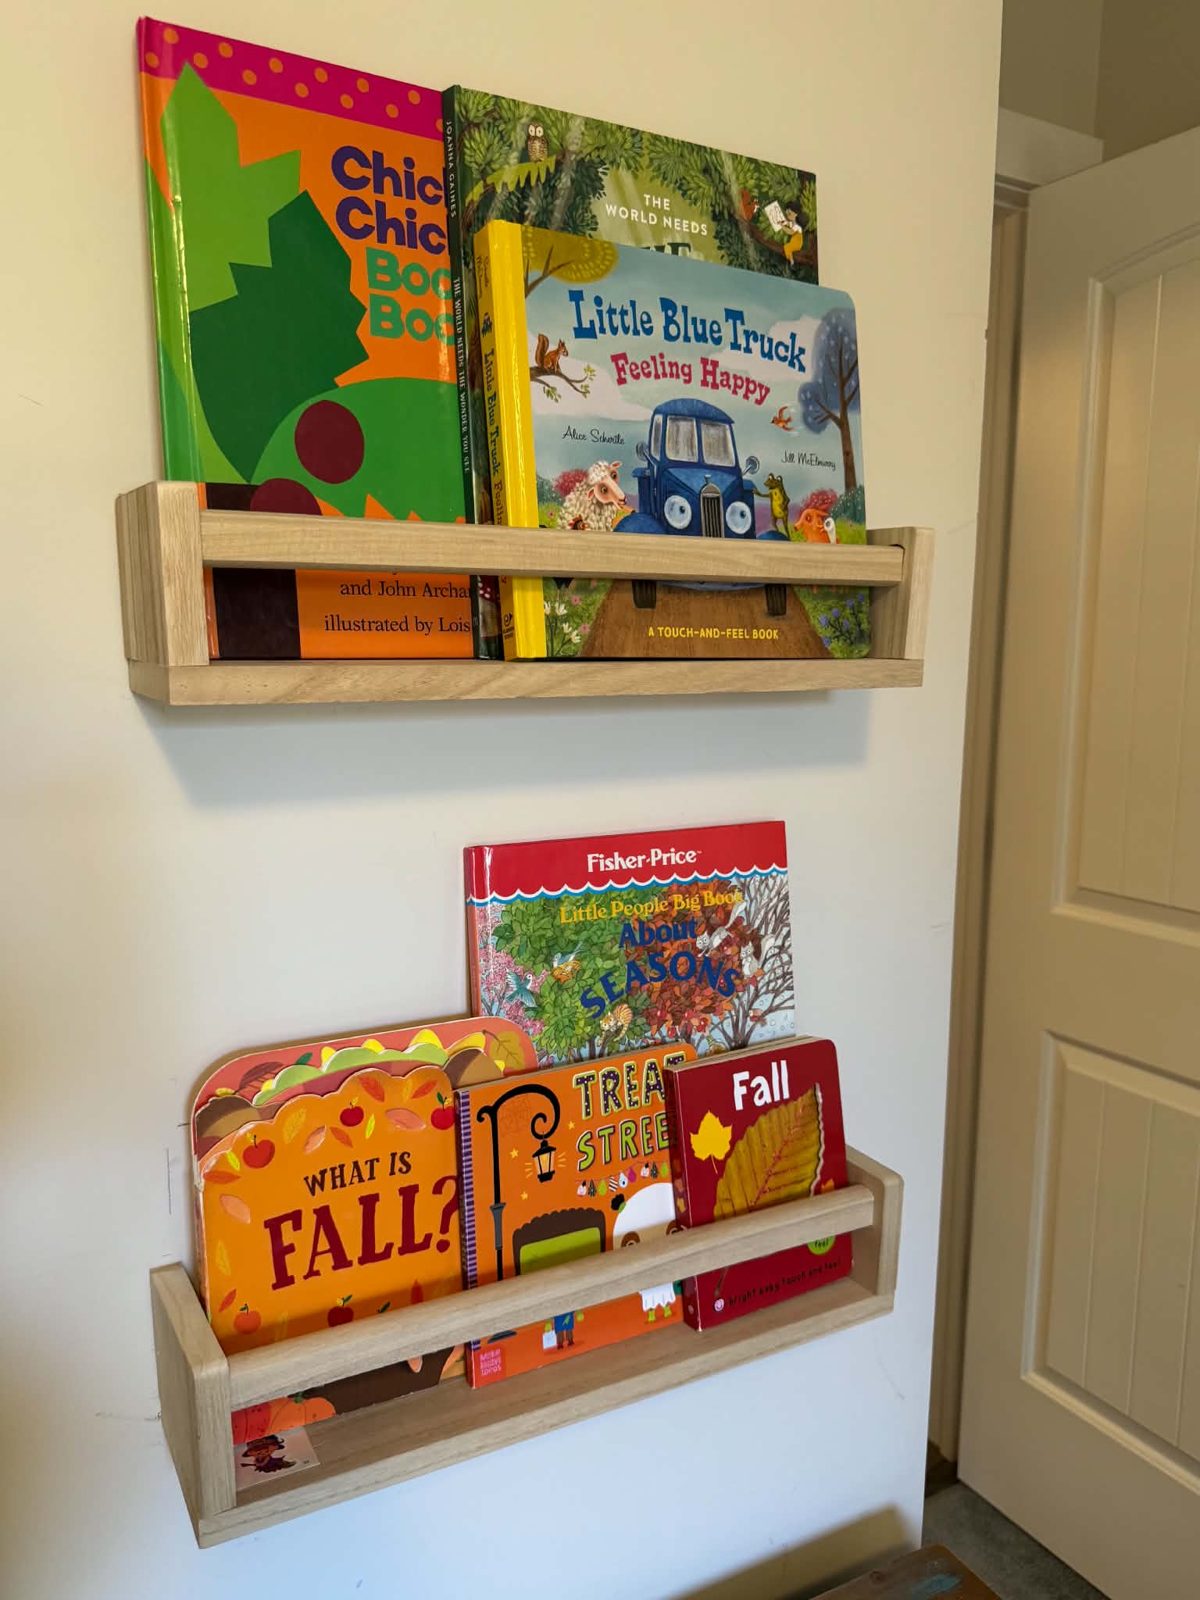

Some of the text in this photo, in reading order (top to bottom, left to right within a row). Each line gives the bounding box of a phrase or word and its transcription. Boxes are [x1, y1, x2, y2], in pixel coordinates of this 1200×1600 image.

[446, 121, 457, 218] JOANNA GAINES
[605, 203, 708, 236] WORLD NEEDS
[643, 194, 671, 211] THE
[335, 196, 451, 256] Chic
[453, 276, 462, 297] THE
[455, 299, 464, 334] WORLD
[568, 290, 806, 373] Little Blue Truck
[457, 336, 465, 368] NEEDS
[611, 352, 771, 406] Feeling Happy
[460, 391, 468, 433] WONDER
[562, 425, 586, 441] Alice
[340, 579, 470, 598] and John Archa
[324, 614, 409, 632] illustrated
[414, 616, 433, 636] by
[439, 617, 470, 632] Lois
[648, 626, 779, 640] A TOUCH-AND-FEEL BOOK
[587, 847, 698, 873] Fisher-Price
[560, 888, 743, 925] Little People Big Book
[618, 917, 698, 949] About
[580, 951, 741, 1020] SEASONS
[732, 1060, 790, 1111] Fall
[576, 1112, 670, 1172] STREE
[303, 1151, 412, 1197] WHAT IS
[263, 1175, 459, 1291] FALL?
